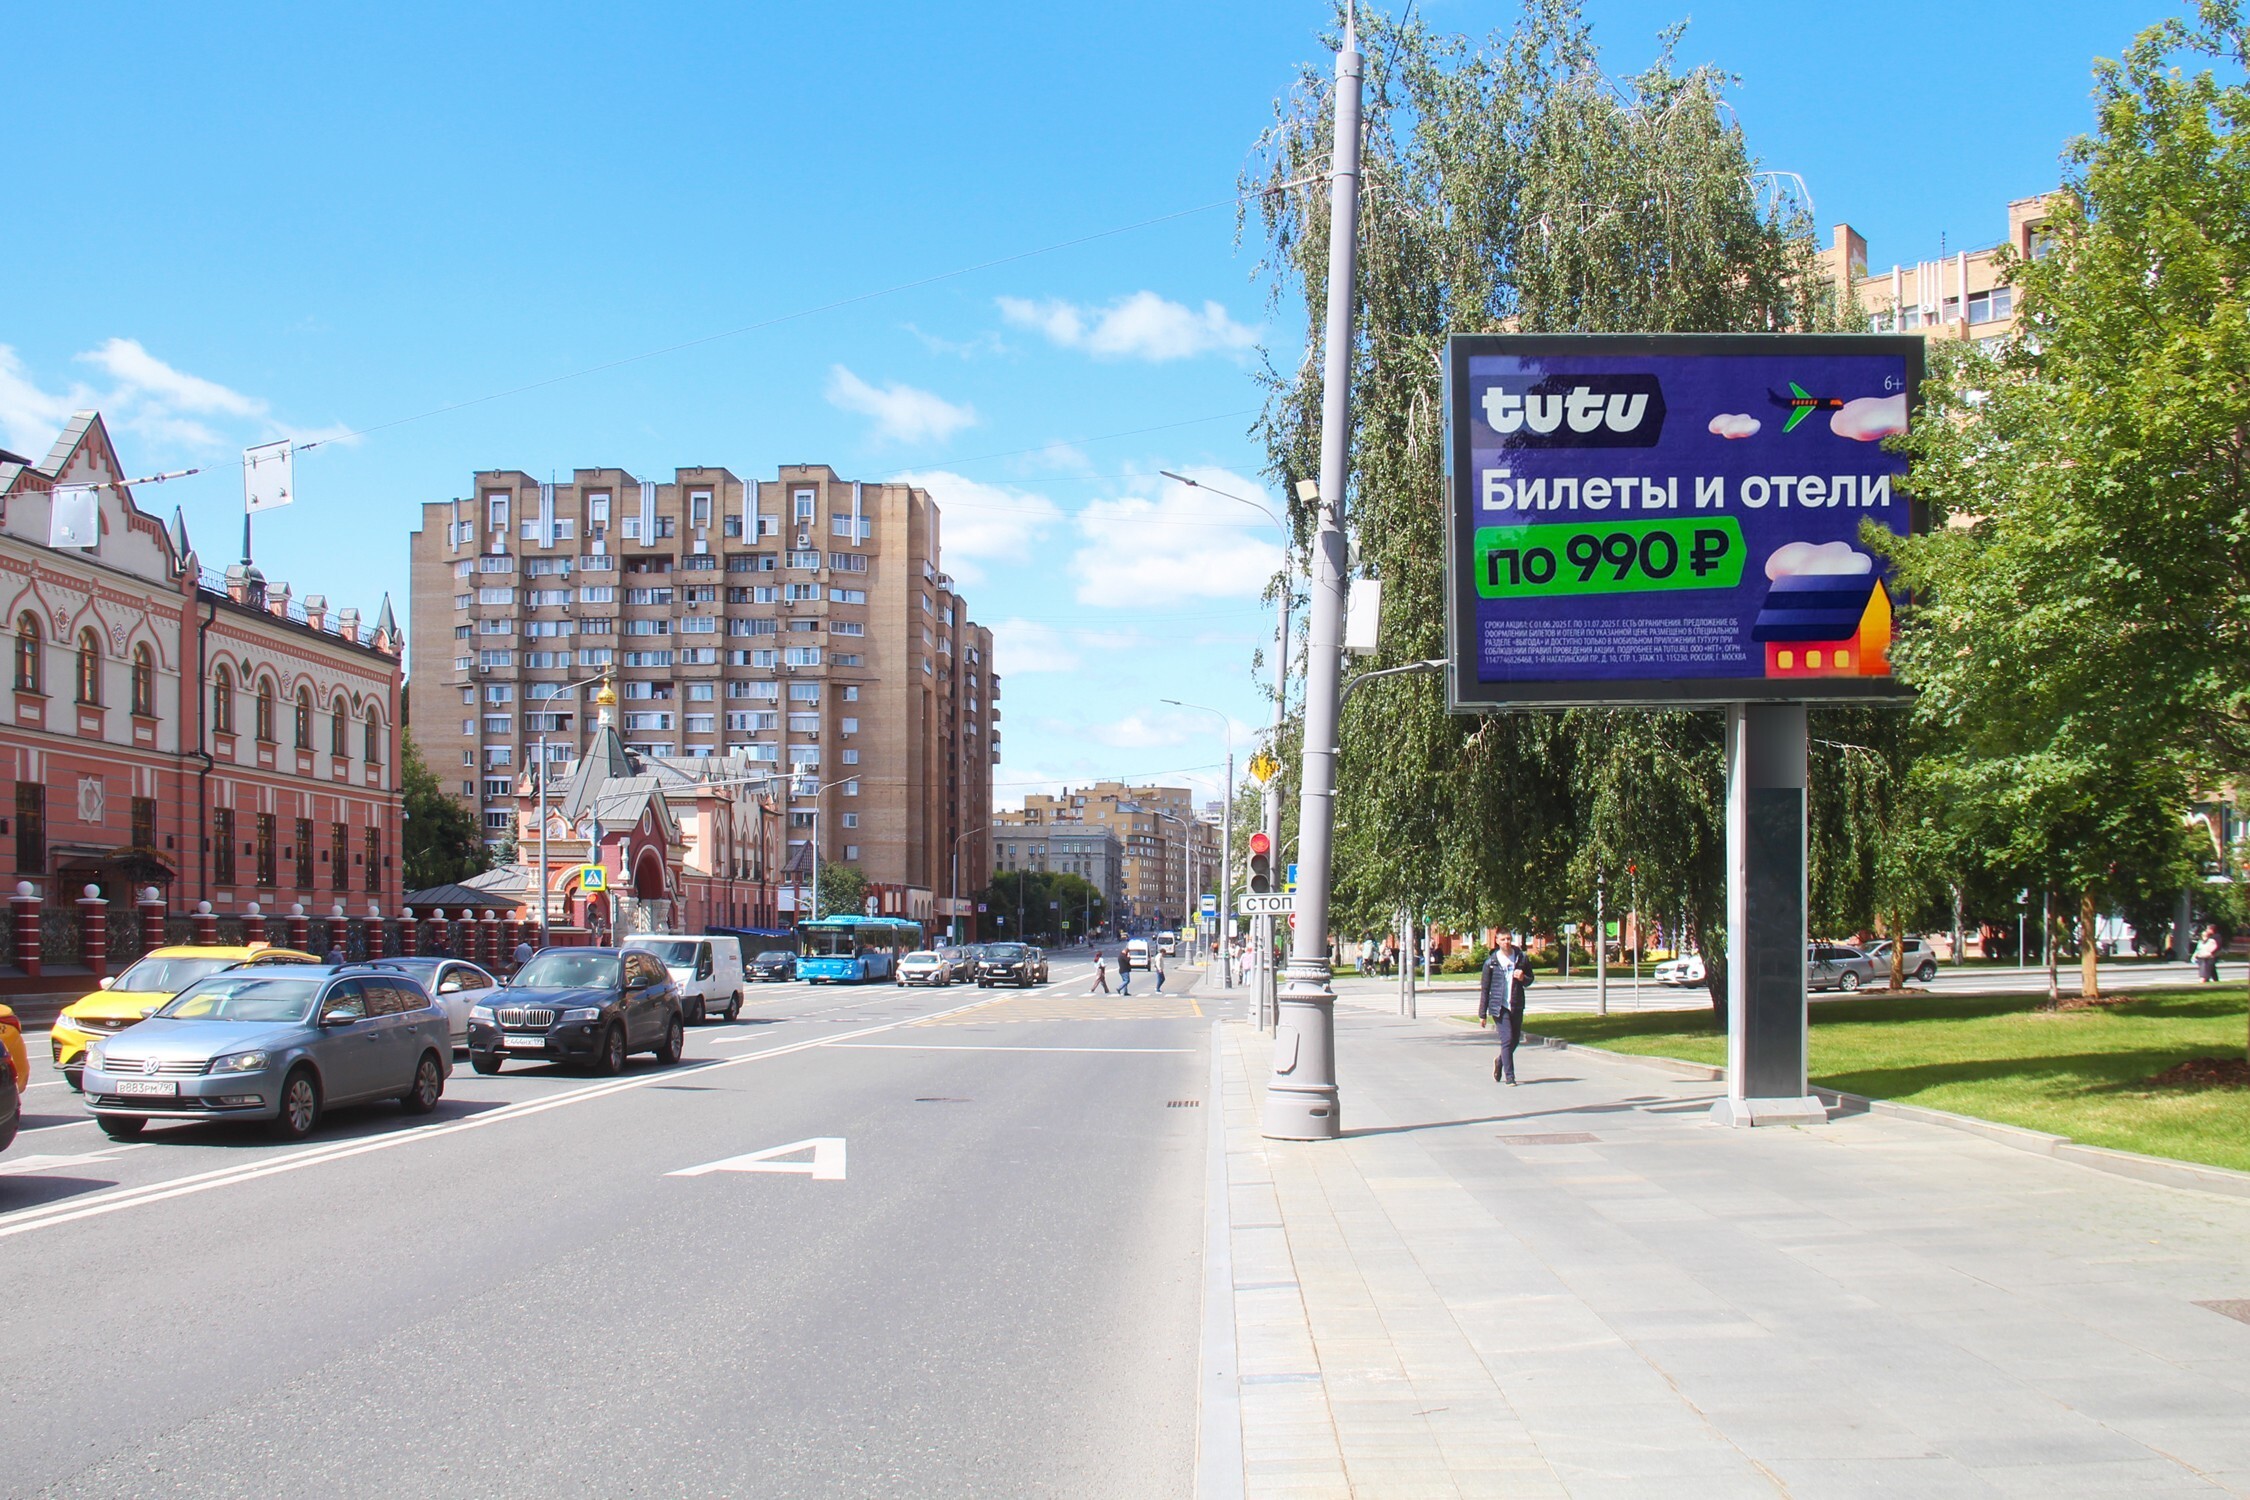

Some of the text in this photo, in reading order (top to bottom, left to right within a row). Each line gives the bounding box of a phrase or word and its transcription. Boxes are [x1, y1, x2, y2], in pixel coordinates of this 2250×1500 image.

[1883, 375, 1903, 391] 6+
[1481, 386, 1649, 433] tutu
[1481, 469, 1891, 511] Билеты и отели
[1488, 548, 1556, 587] по
[1566, 530, 1678, 583] 990
[1246, 897, 1292, 911] СТОП
